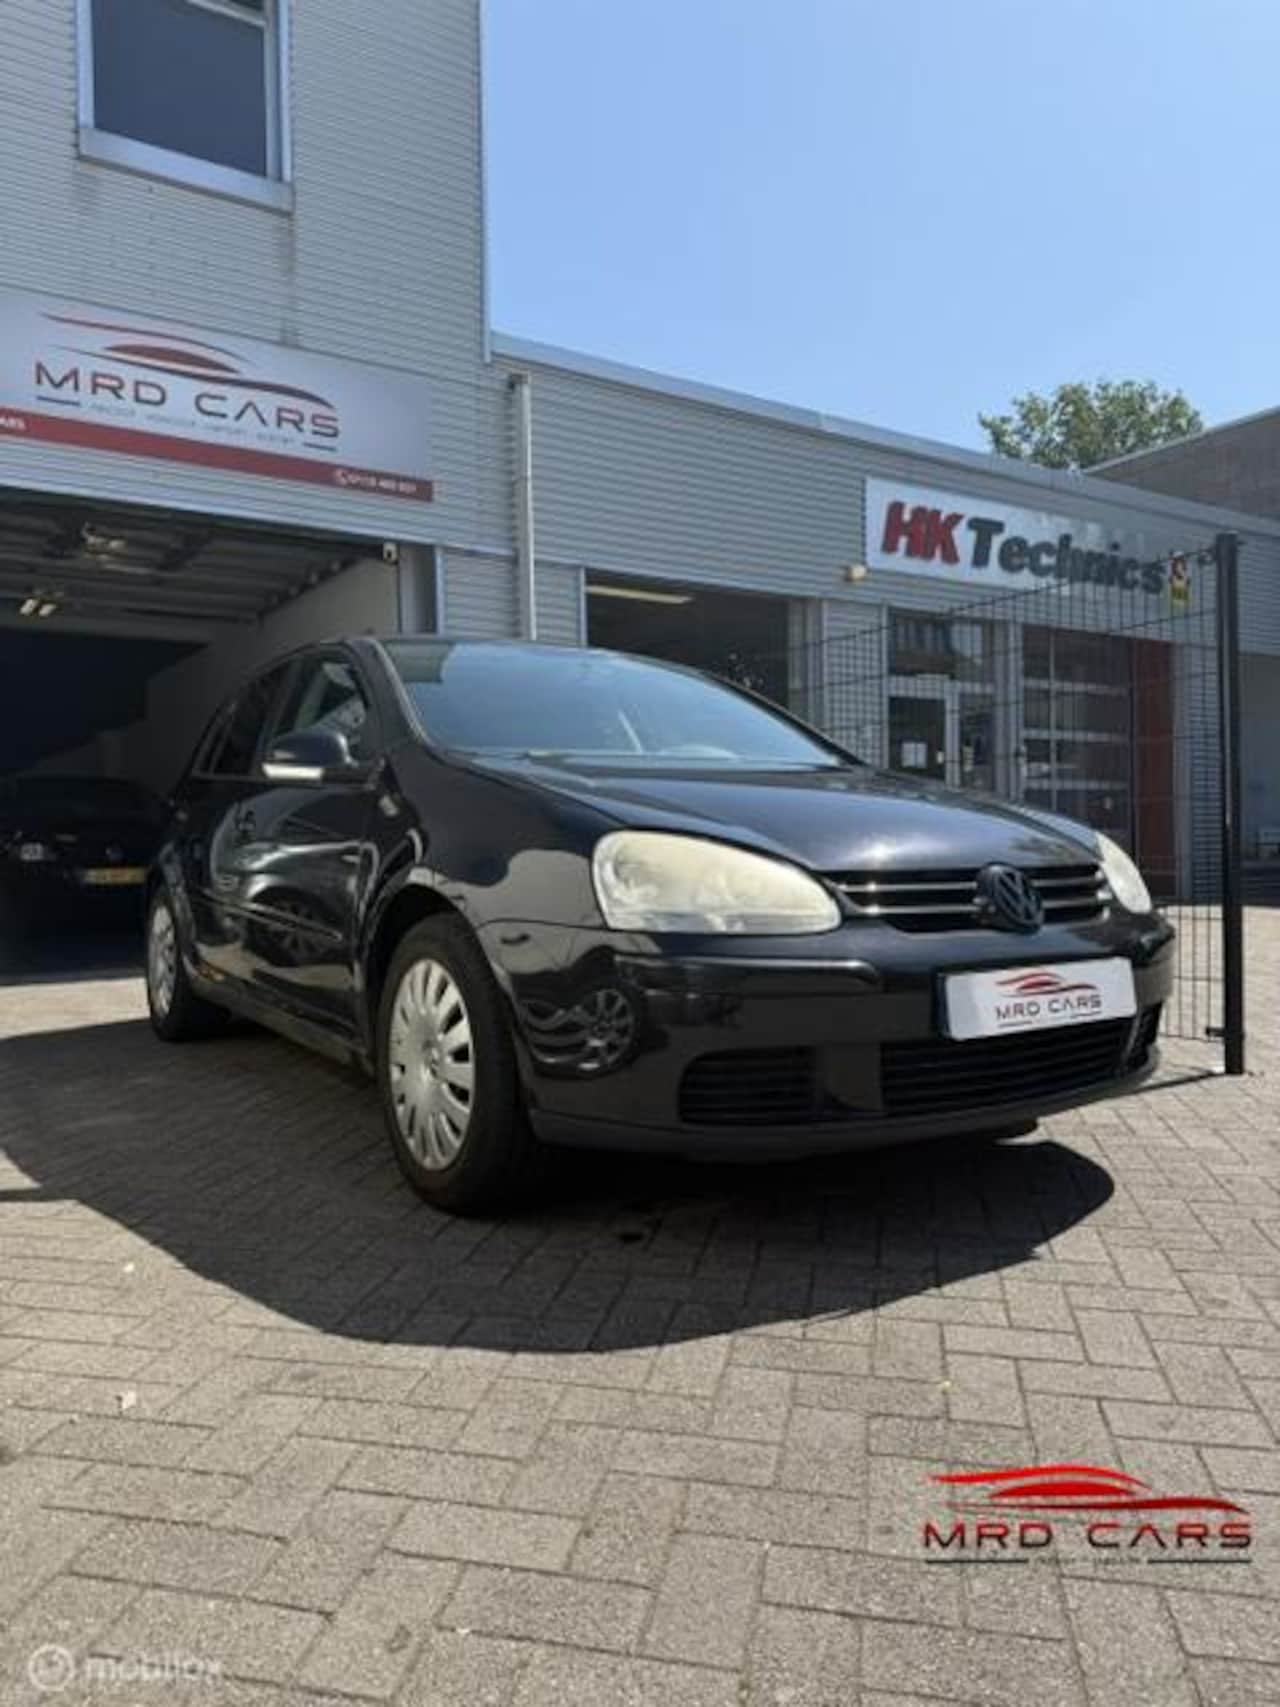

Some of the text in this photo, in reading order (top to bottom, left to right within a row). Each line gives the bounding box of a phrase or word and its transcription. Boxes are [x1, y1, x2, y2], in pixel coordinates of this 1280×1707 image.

[35, 361, 166, 406] MRD
[195, 393, 339, 438] CARS
[881, 500, 1166, 594] HK Technics
[996, 1002, 1040, 1021] MRD
[1048, 995, 1102, 1013] CARS
